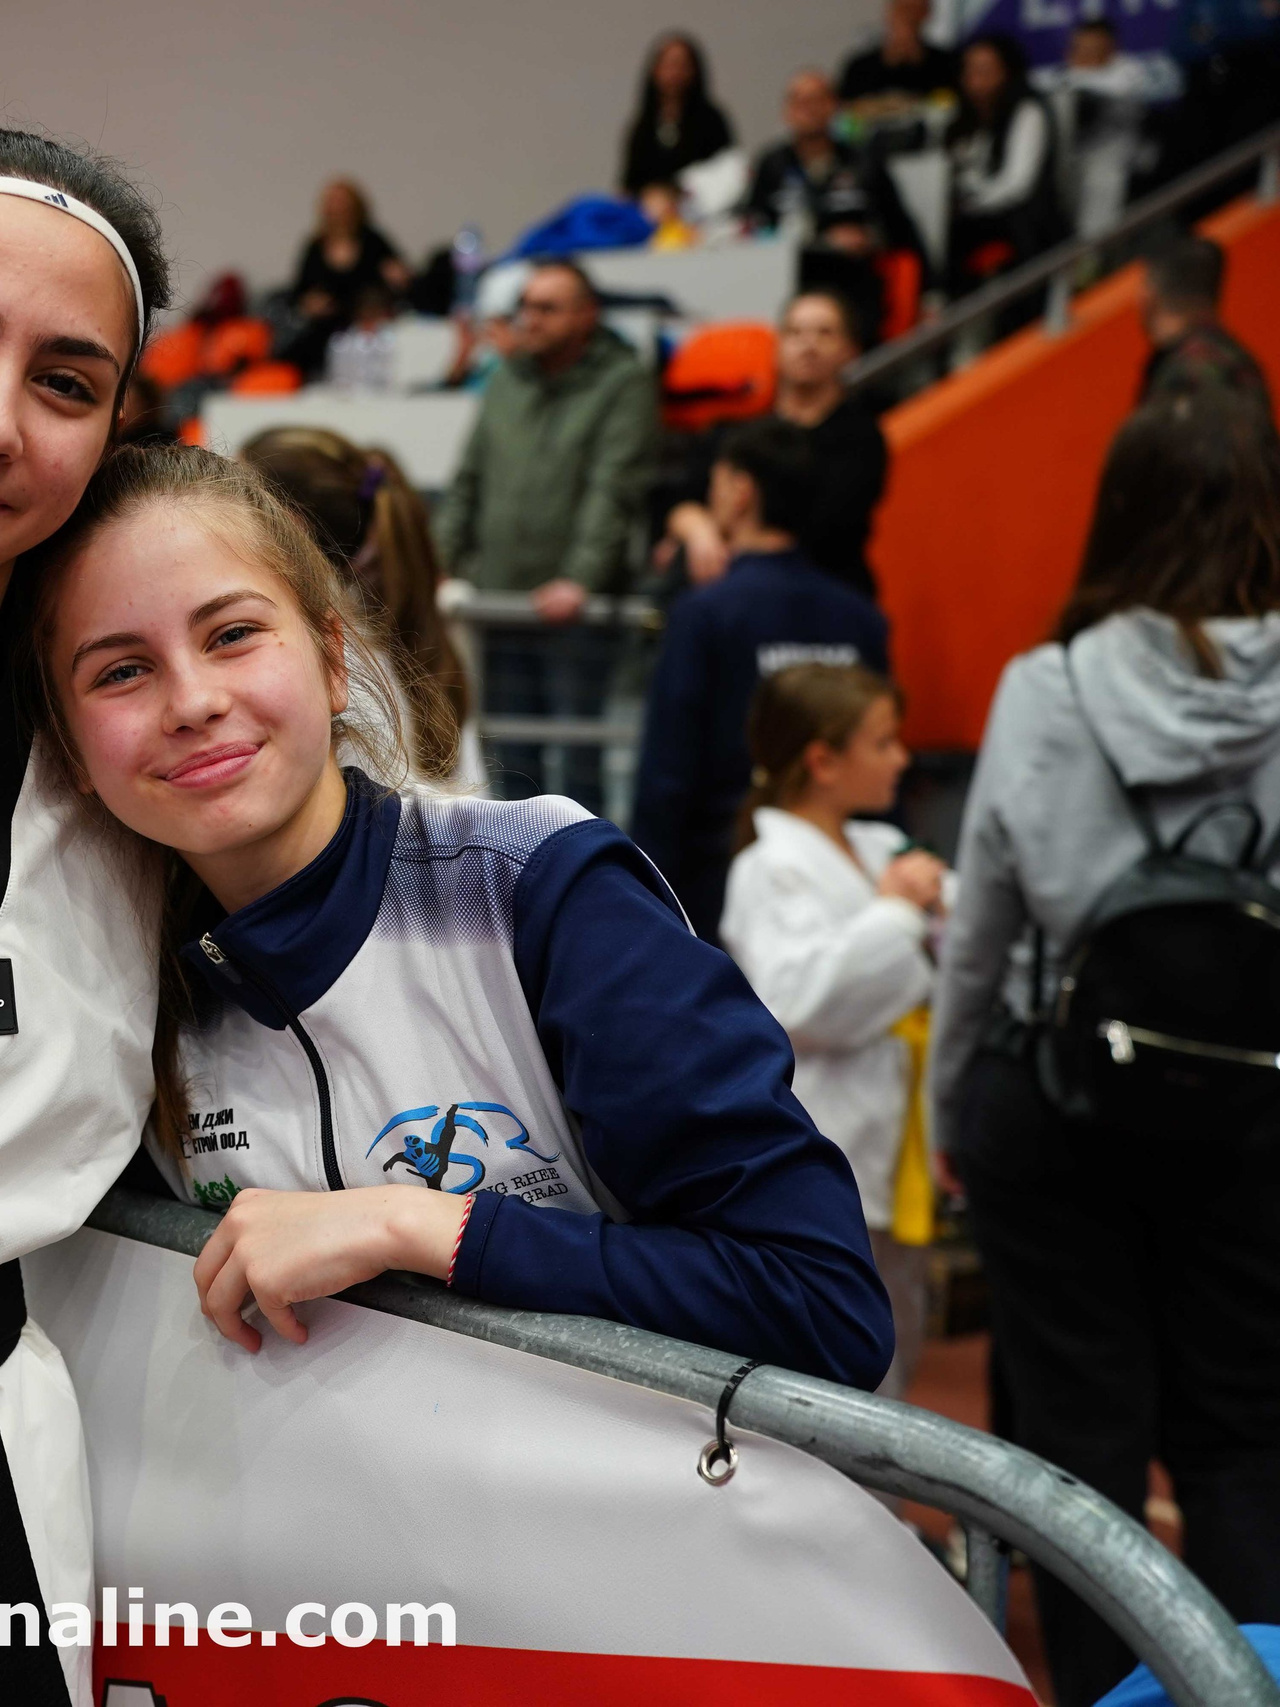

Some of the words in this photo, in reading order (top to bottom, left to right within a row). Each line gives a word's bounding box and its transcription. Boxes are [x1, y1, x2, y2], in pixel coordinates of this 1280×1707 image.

[201, 1107, 233, 1131] ДЖИ
[191, 1131, 218, 1154] СТРОЙ
[220, 1130, 250, 1151] ООД
[510, 1167, 560, 1190] RHEE
[521, 1183, 568, 1204] GRAD
